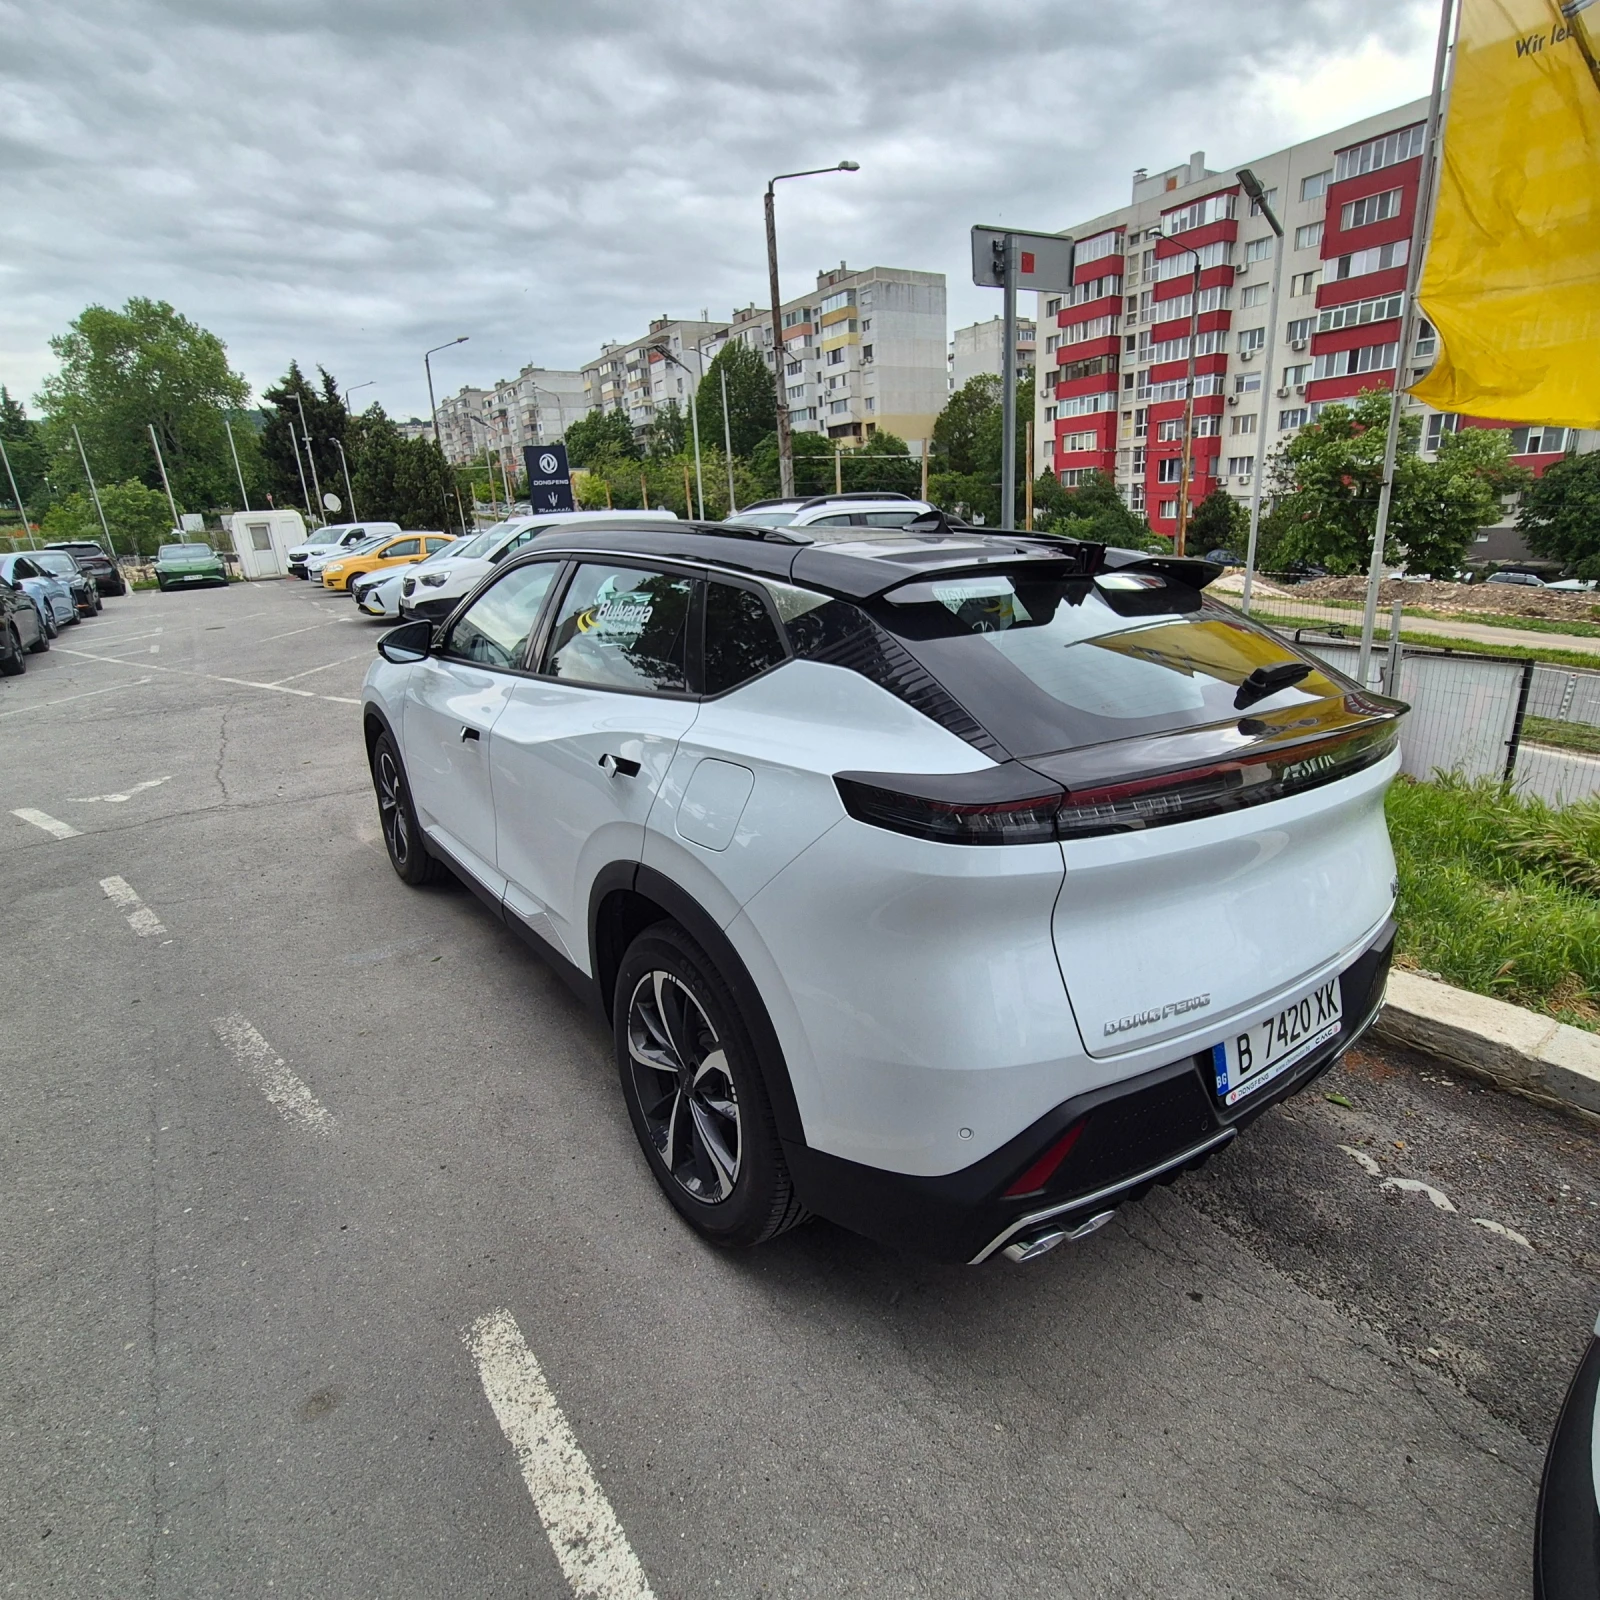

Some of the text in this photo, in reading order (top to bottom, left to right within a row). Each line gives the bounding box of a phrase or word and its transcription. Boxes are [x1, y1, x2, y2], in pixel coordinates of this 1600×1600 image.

[1516, 34, 1545, 58] Wir
[596, 600, 654, 623] Bulvaria
[1103, 993, 1211, 1037] DONGFENG
[1236, 978, 1339, 1076] B 7420 XK
[1216, 1072, 1228, 1089] BG
[1238, 1072, 1270, 1097] DONGFENG
